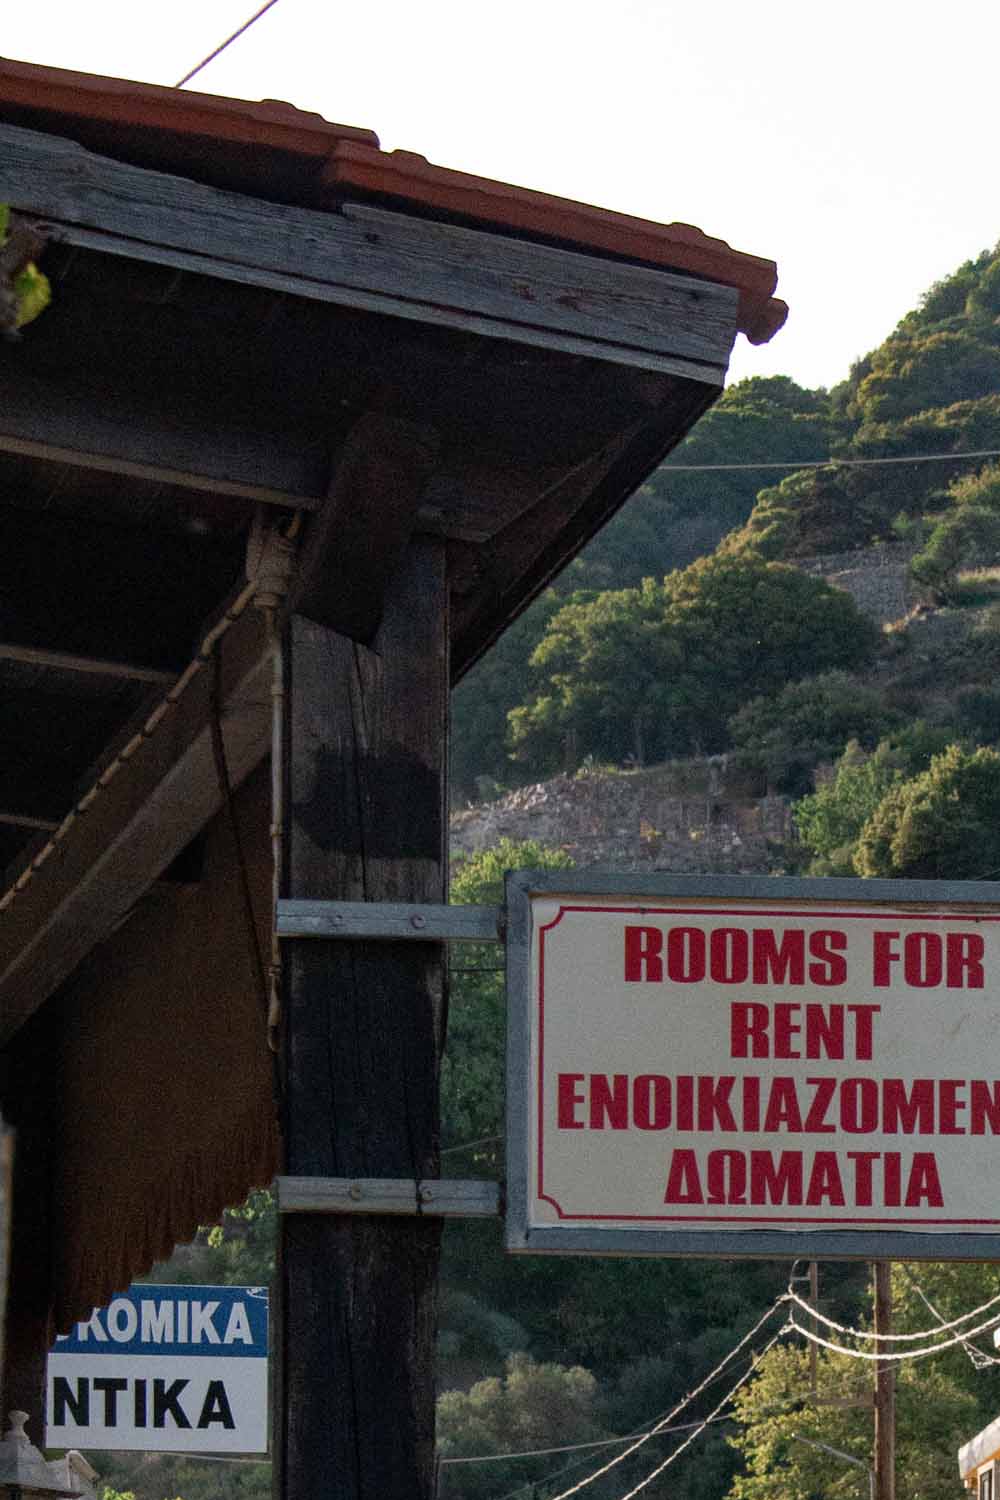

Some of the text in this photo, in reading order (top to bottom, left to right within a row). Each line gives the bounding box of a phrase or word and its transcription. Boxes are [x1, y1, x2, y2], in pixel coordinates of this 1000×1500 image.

[624, 926, 984, 989] ROOMS FOR
[730, 1001, 881, 1061] RENT
[664, 1149, 945, 1208] ΔΩΜΑΤΙΑ
[56, 1298, 254, 1344] ΚΟΜΙΚΑ
